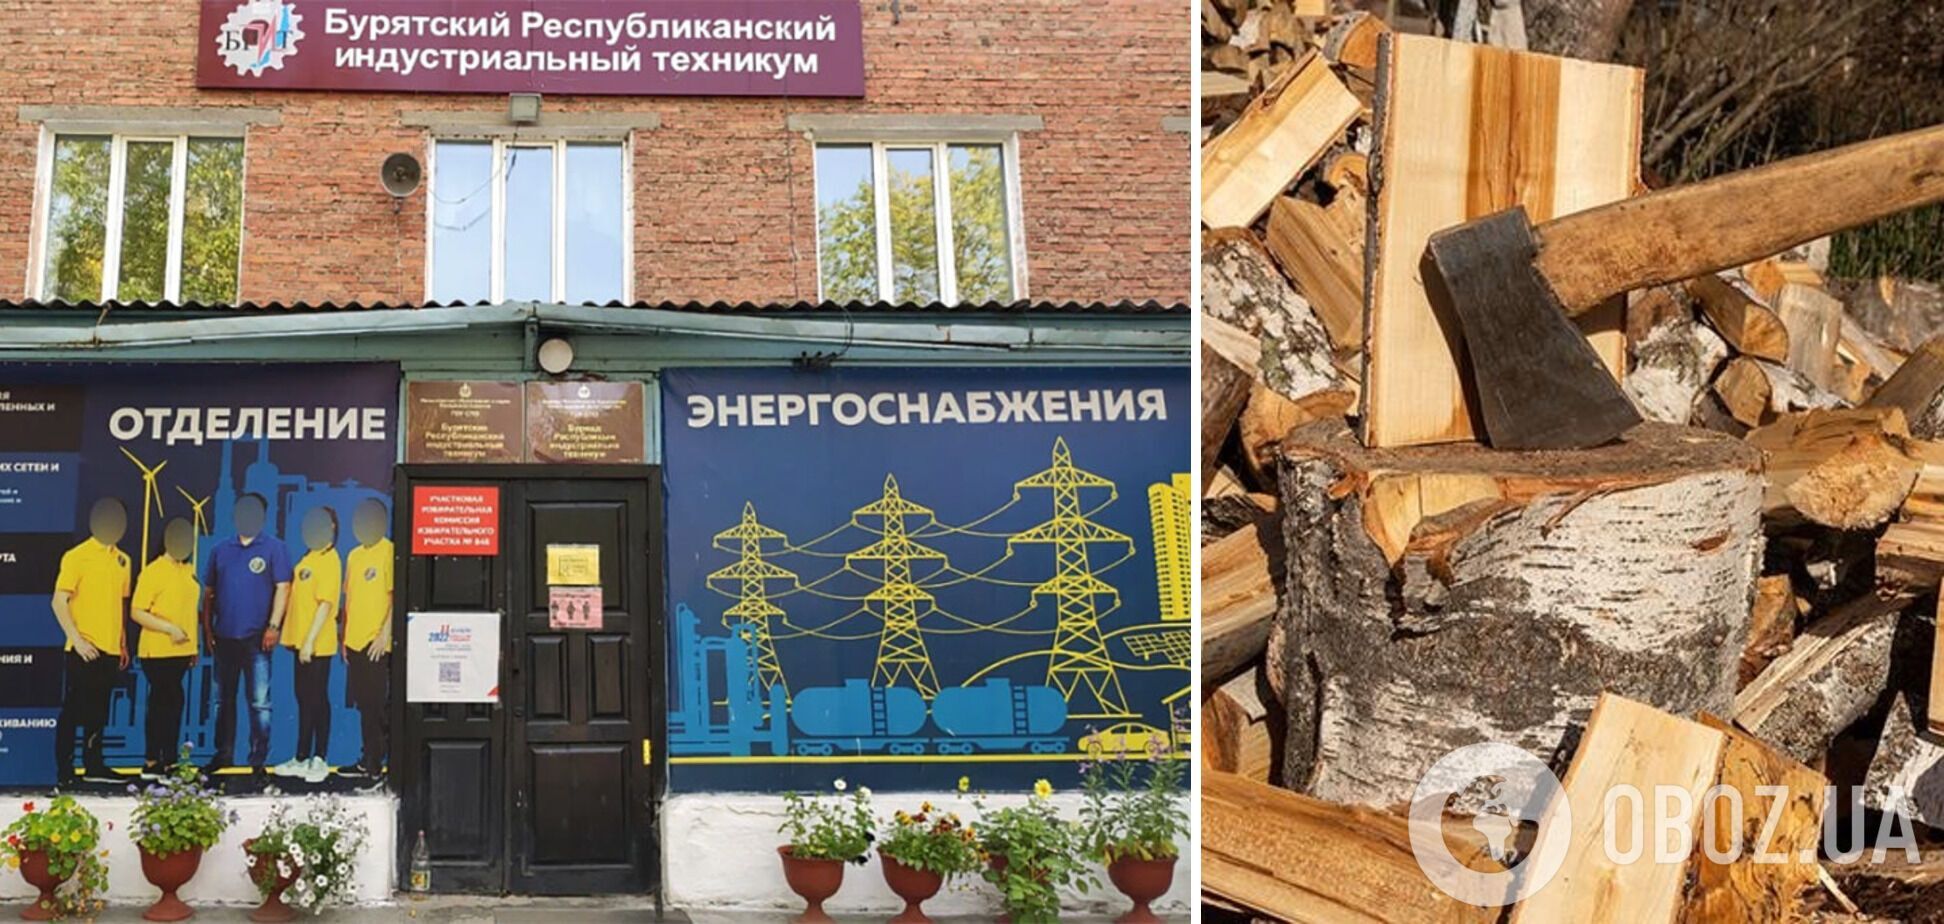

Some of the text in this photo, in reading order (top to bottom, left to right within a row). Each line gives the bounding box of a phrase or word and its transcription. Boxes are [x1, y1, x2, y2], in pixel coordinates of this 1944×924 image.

[324, 8, 837, 46] Бурятский Республиканский
[335, 44, 819, 80] индустриальный техникум
[108, 406, 387, 446] ОТДЕЛЕНИЕ
[687, 388, 1168, 428] ЭНЕРГОСНАБЖЕНИЯ
